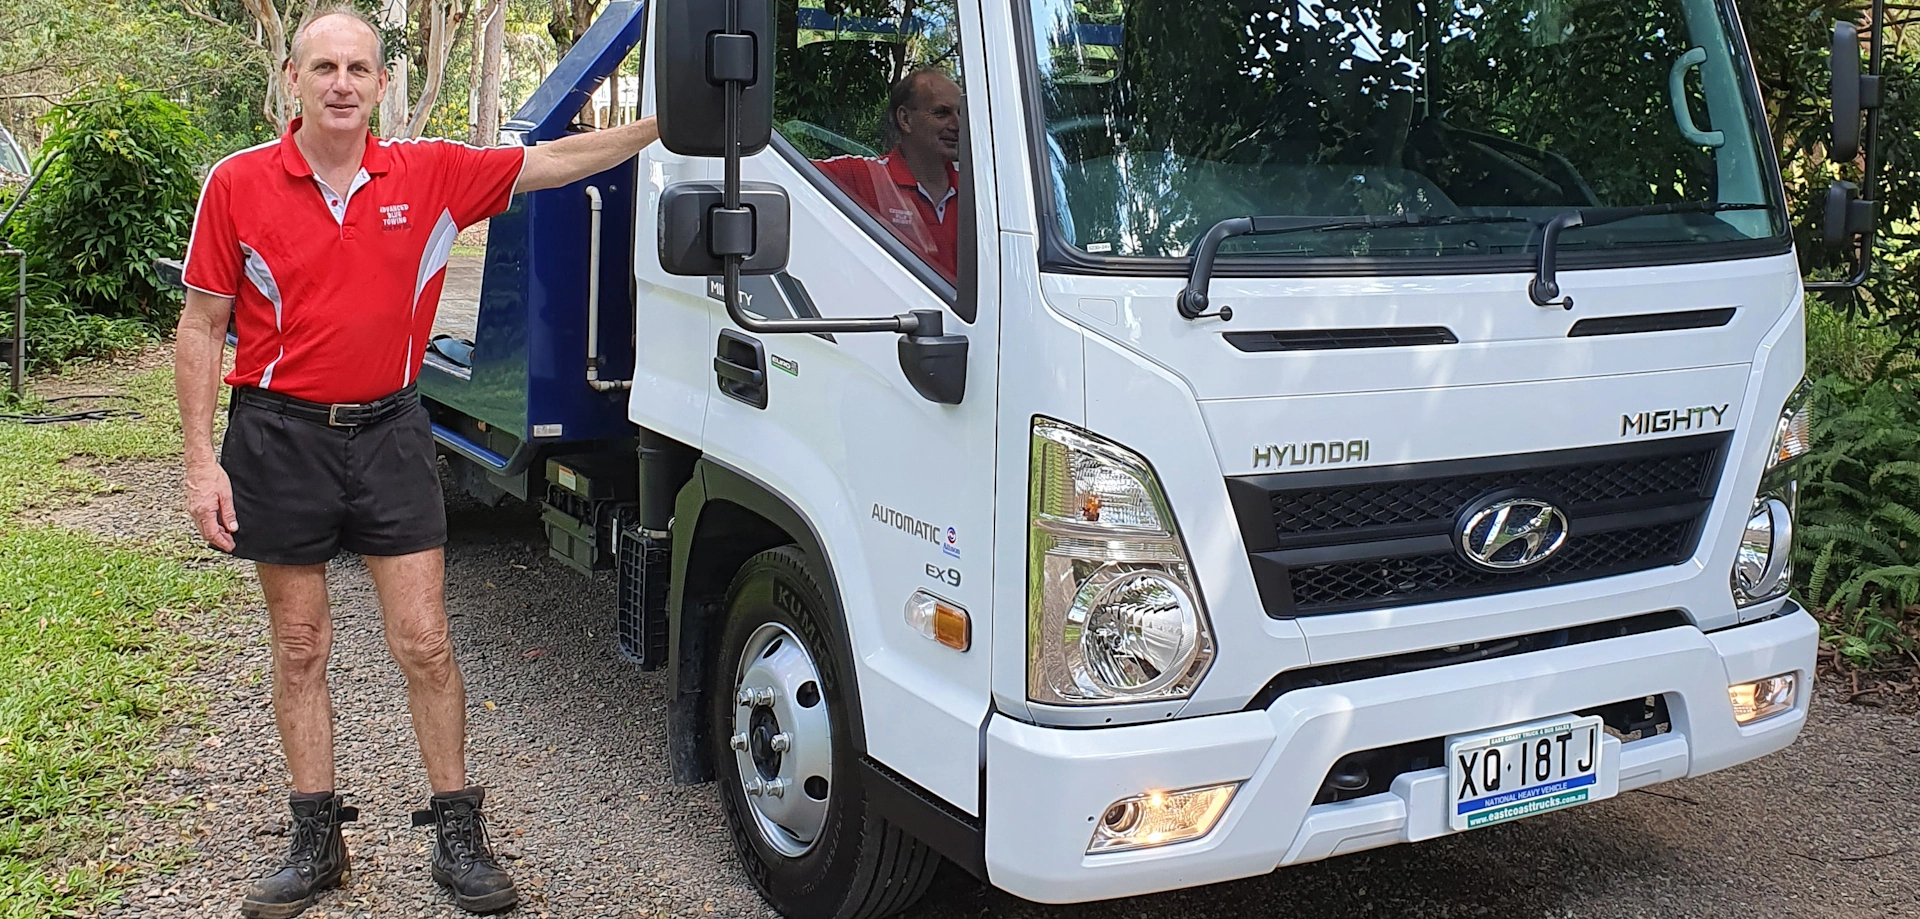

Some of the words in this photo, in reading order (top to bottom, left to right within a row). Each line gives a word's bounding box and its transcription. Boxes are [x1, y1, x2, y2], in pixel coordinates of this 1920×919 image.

[382, 217, 407, 226] TOWING
[710, 281, 753, 306] MITY
[1621, 404, 1729, 437] MIGHTY
[1253, 440, 1369, 468] HYUNDAI
[871, 503, 940, 545] AUTOMATIC
[778, 585, 834, 690] KUMHO
[1491, 737, 1504, 745] EAST
[1505, 734, 1521, 742] COAST
[1485, 794, 1517, 807] NATIONAL
[1518, 788, 1540, 800] HEAVY
[1541, 782, 1567, 796] VEHICLE
[1470, 794, 1586, 826] www.eastcoasttrucks.com.au
